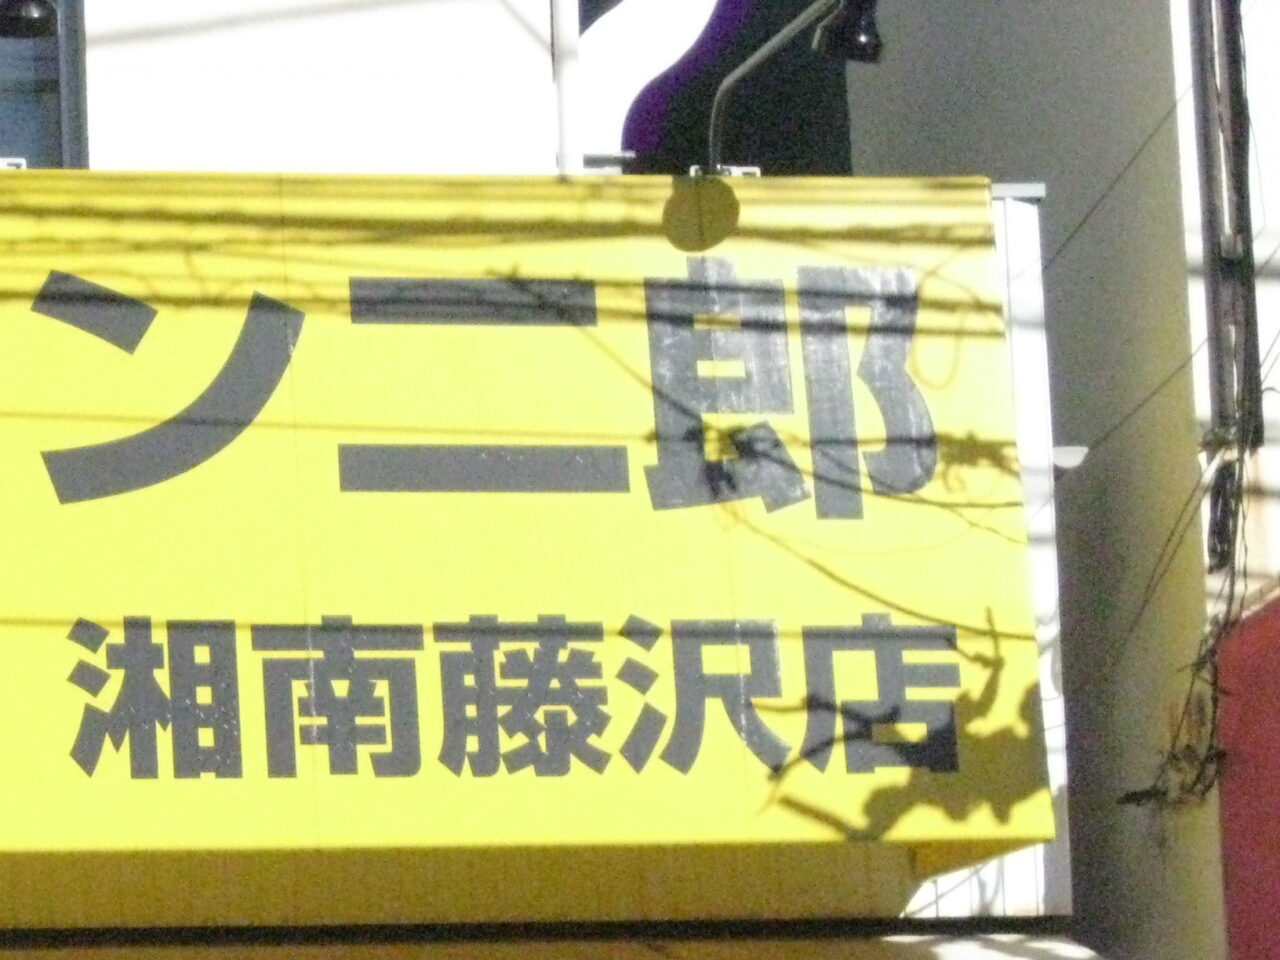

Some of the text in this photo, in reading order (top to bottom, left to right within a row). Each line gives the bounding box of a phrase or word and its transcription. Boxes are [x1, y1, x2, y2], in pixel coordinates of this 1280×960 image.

[67, 612, 962, 779] 湘南藤沢店
